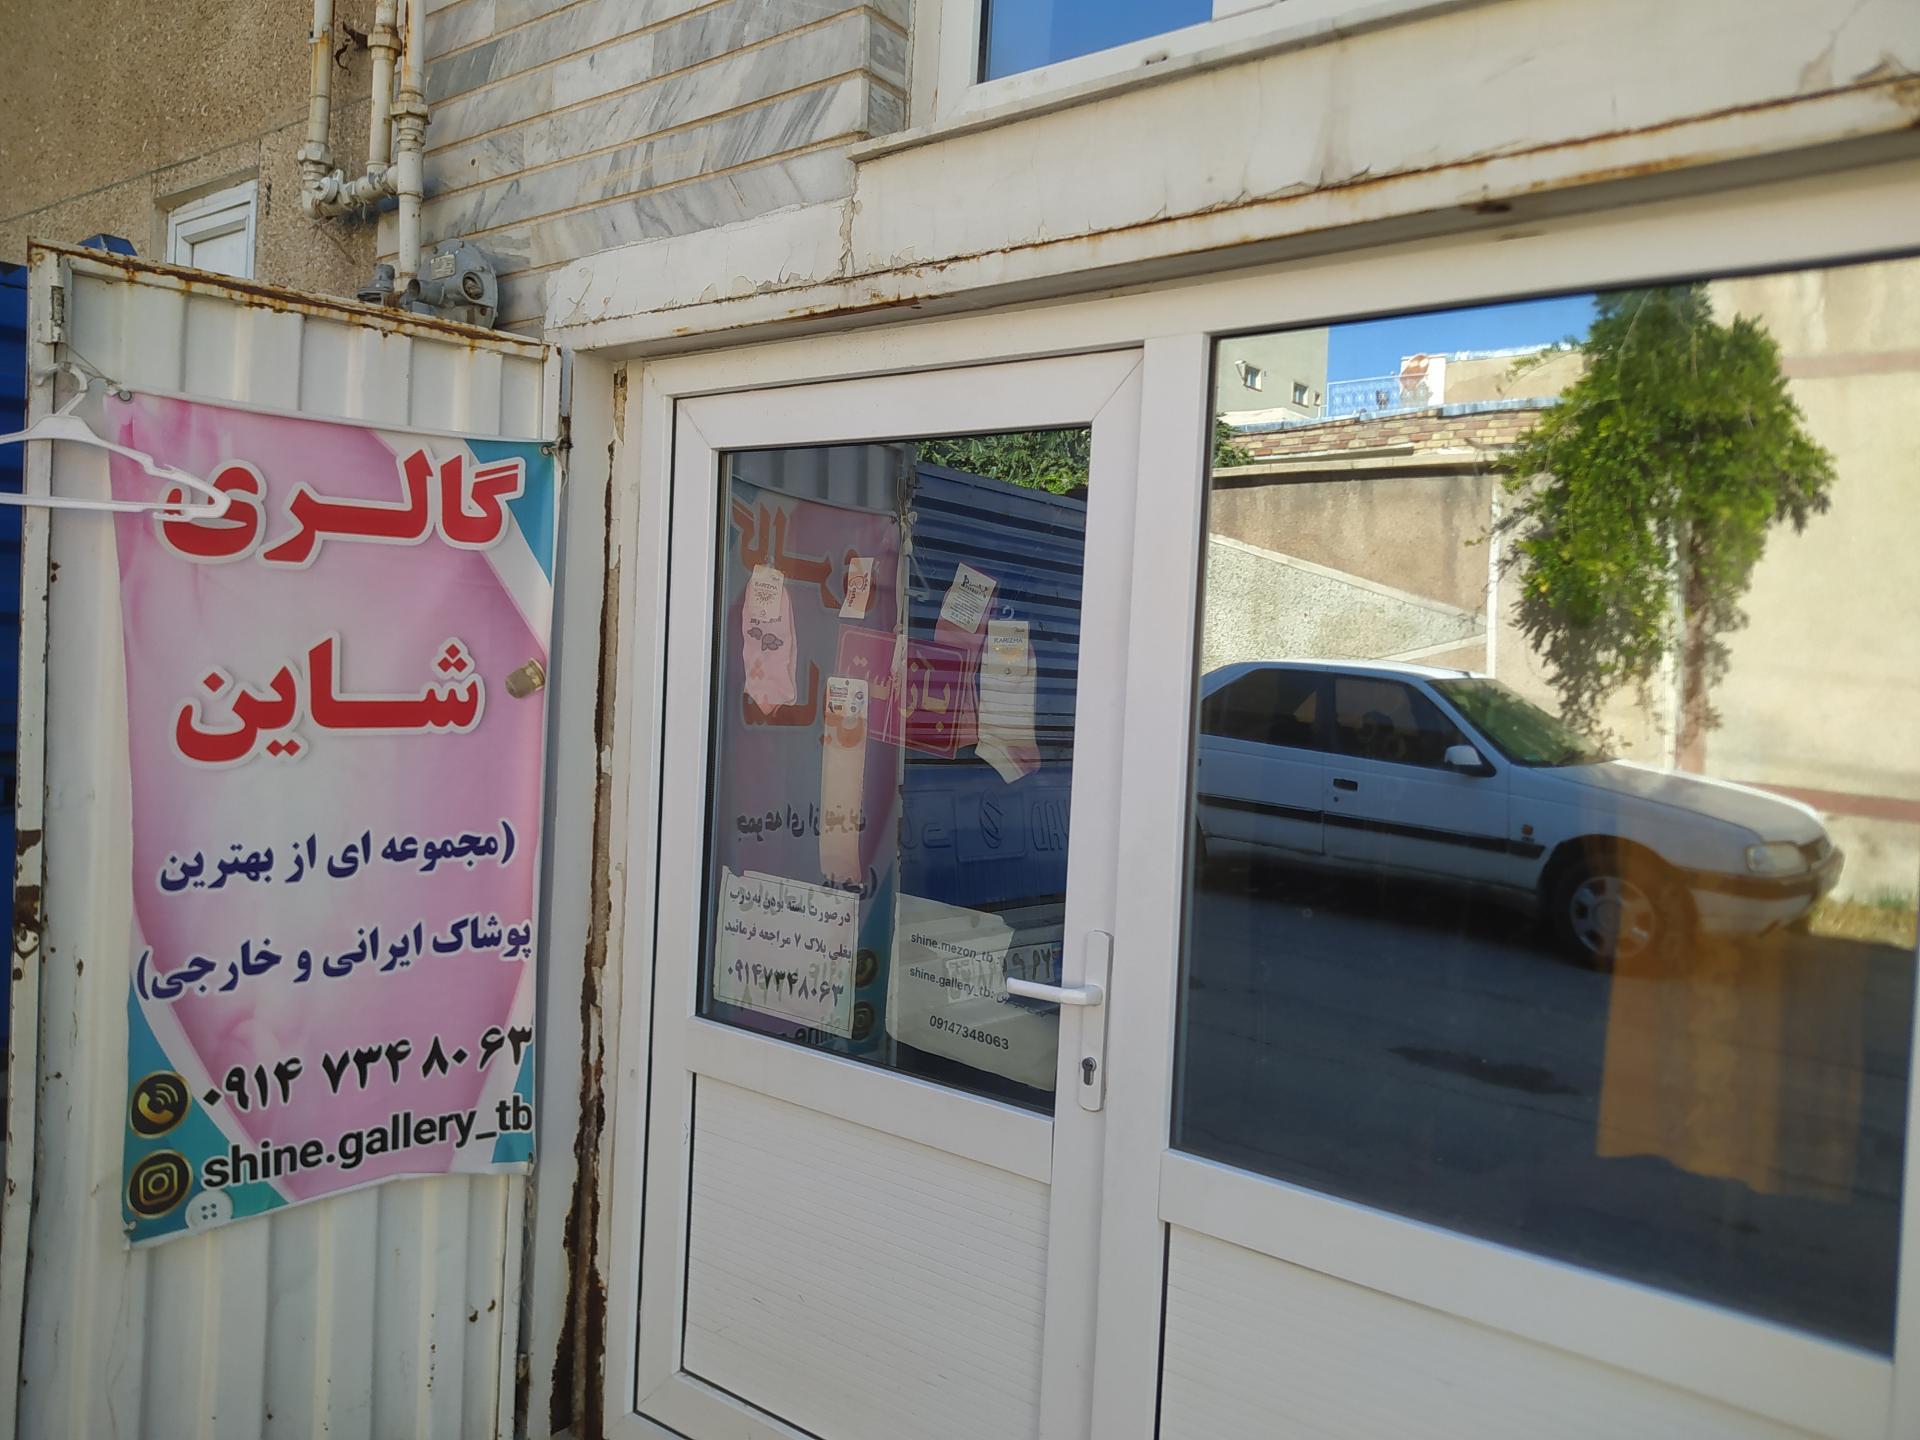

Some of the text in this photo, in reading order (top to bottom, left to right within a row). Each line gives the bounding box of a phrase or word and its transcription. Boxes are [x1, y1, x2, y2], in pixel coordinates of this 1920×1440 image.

[164, 449, 519, 563] گالری
[176, 638, 478, 762] شاین
[160, 843, 275, 891] بهترین
[284, 834, 317, 884] از
[327, 830, 371, 878] ای
[763, 897, 784, 912] بودن
[786, 900, 806, 918] بسته
[808, 905, 838, 924] صورت
[838, 911, 851, 927] در
[322, 922, 423, 978] ایرانی
[431, 914, 532, 958] پوشاک
[759, 928, 791, 948] مراجعه
[794, 933, 801, 947] ۷
[804, 938, 827, 958] پلاک
[829, 944, 851, 963] بغلی
[911, 933, 993, 963] shine.mezon_tb
[293, 949, 312, 983] و
[728, 958, 844, 1007] ۰۹۱۴۷۳۴۸۰۶۳
[929, 1015, 1009, 1050] 09147348063
[203, 1056, 304, 1111] ۰۹۱۴
[203, 1095, 533, 1187] shine.gallery_tb
